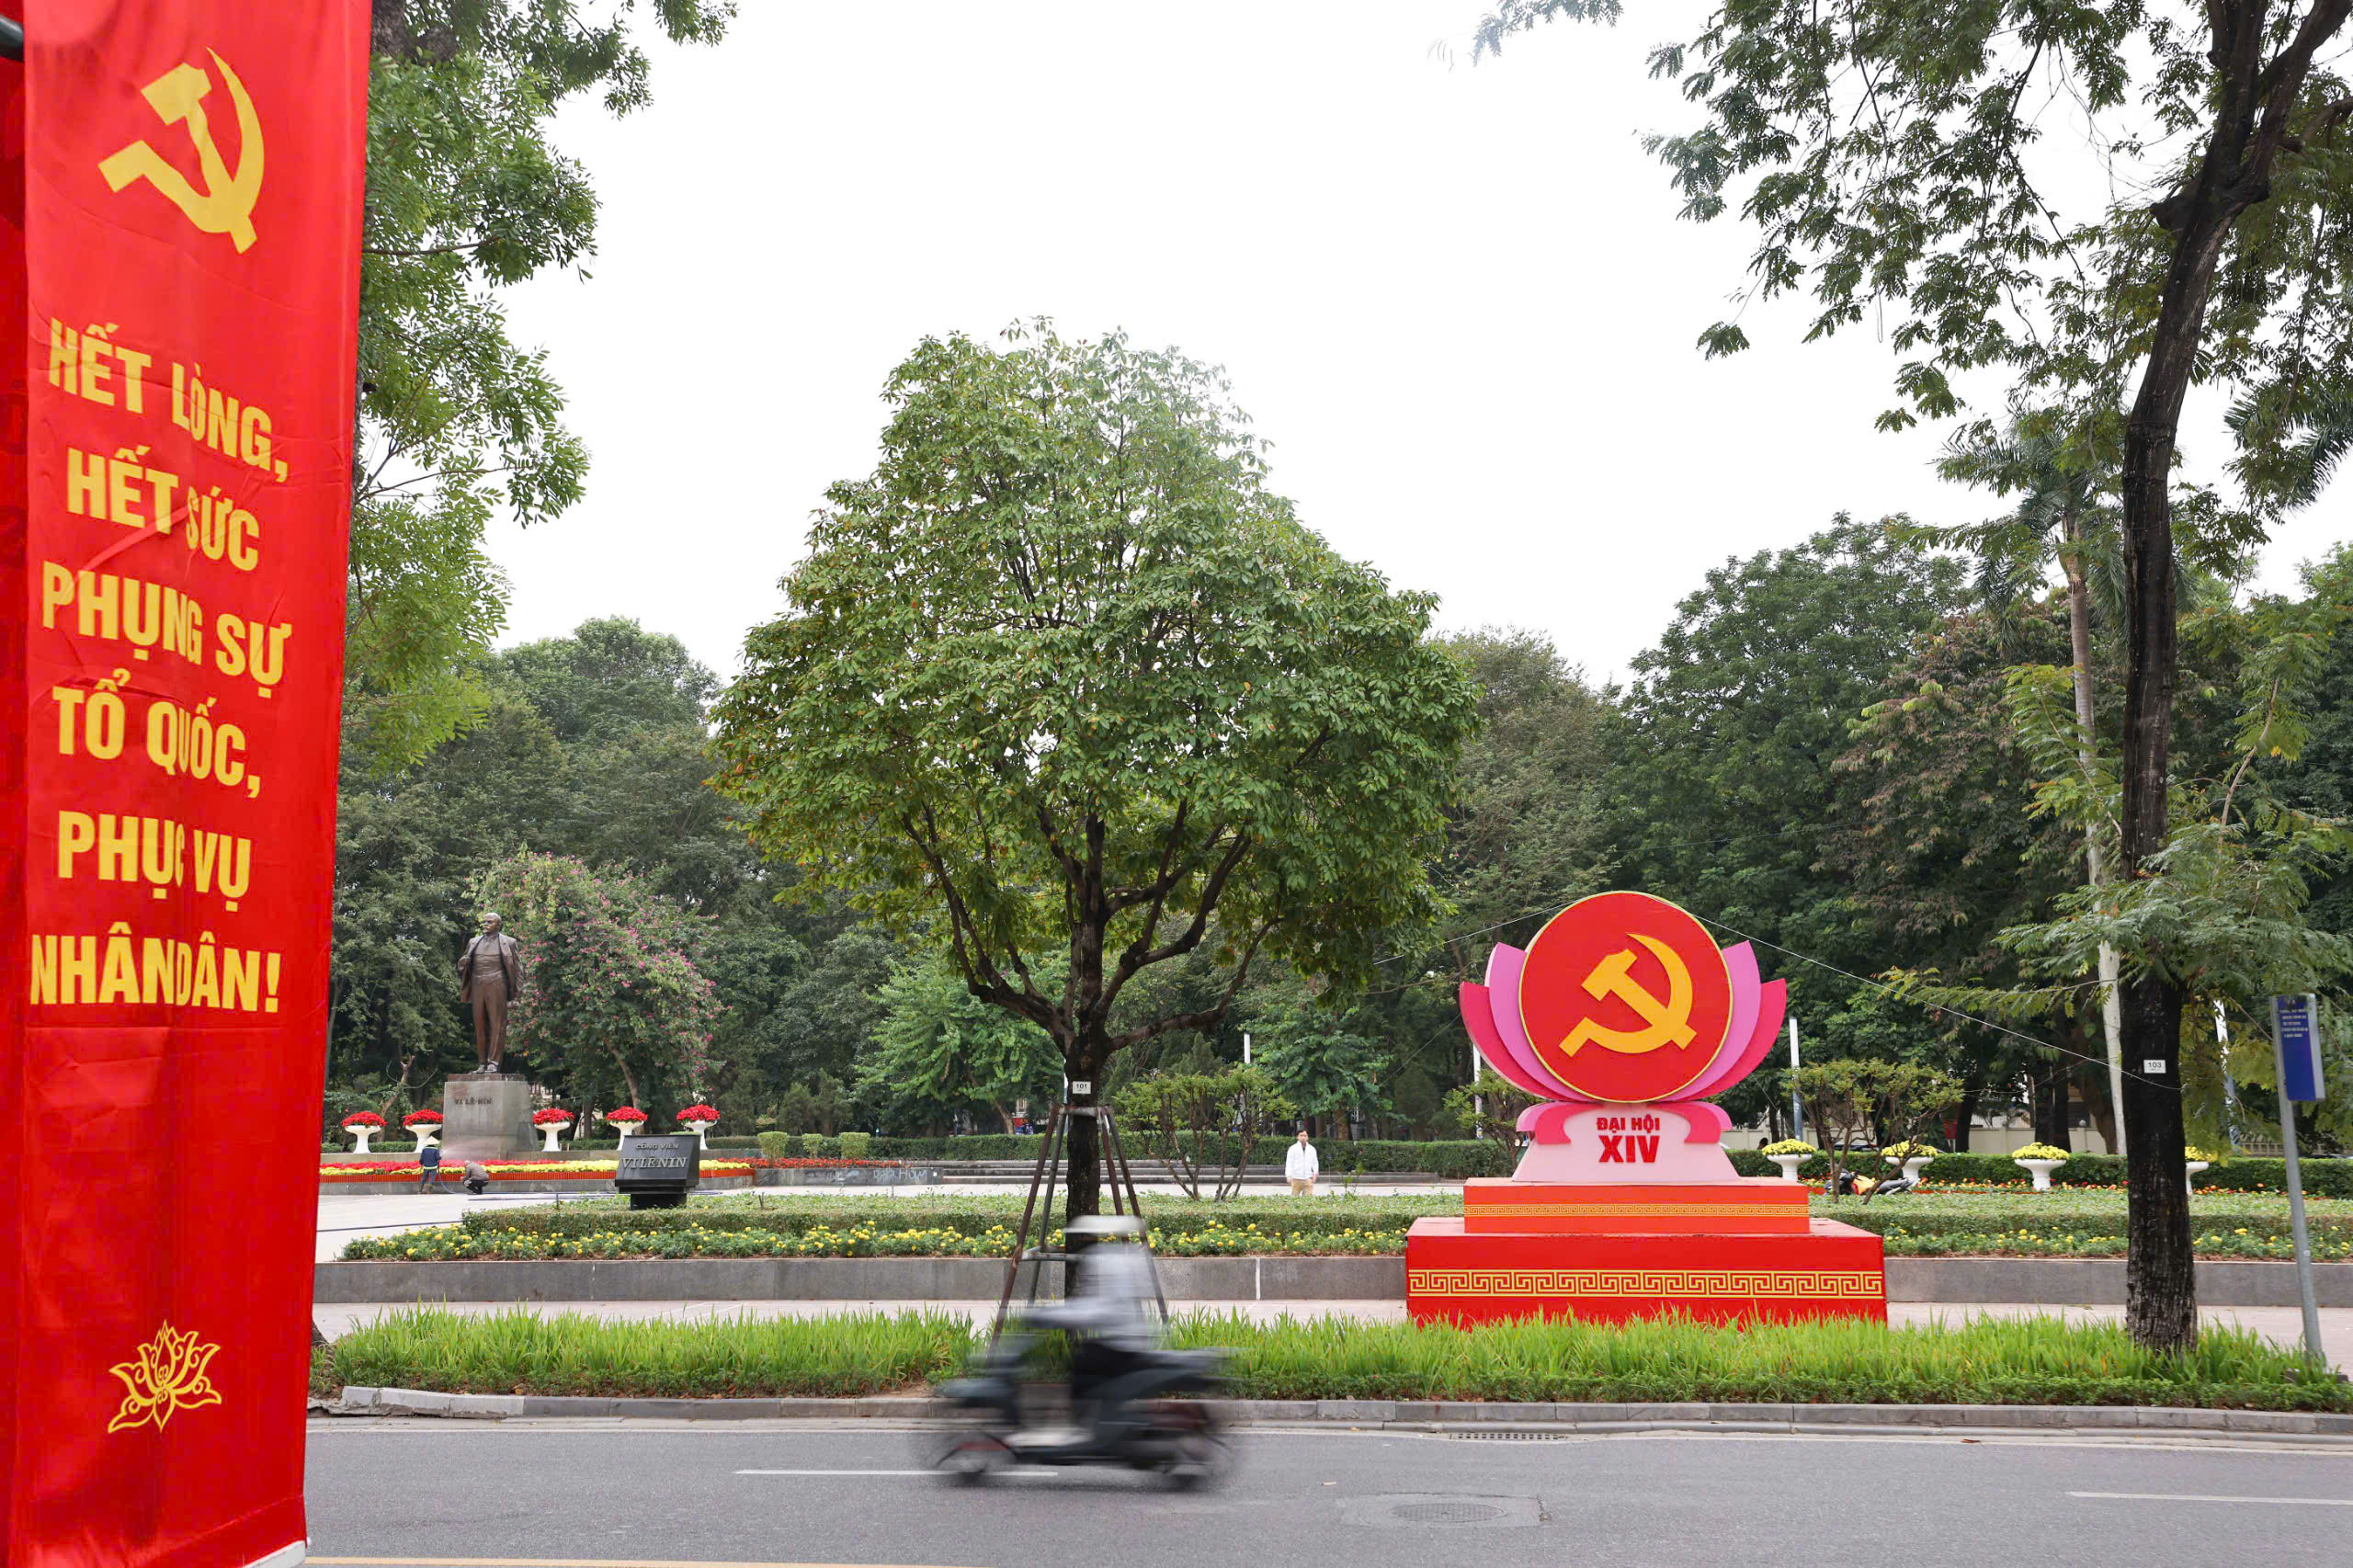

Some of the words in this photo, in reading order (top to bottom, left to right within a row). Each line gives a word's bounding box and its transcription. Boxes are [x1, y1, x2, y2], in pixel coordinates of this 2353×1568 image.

[49, 317, 152, 415] HẾT
[172, 361, 288, 483] LÒNG,
[67, 445, 179, 535] HẾT
[186, 485, 259, 572] SỨC
[42, 560, 203, 665] PHỤNG
[214, 612, 292, 699] SỰ
[51, 667, 131, 761] TỔ
[146, 696, 261, 799] QUỐC,
[58, 810, 185, 900] PHỤC
[194, 829, 251, 913] VỤ
[30, 921, 175, 1006] NHÂN
[176, 930, 281, 1014] DÂN!
[1597, 1117, 1626, 1133] ĐẠI
[1631, 1113, 1660, 1133] HỘI
[1598, 1135, 1660, 1163] XIV
